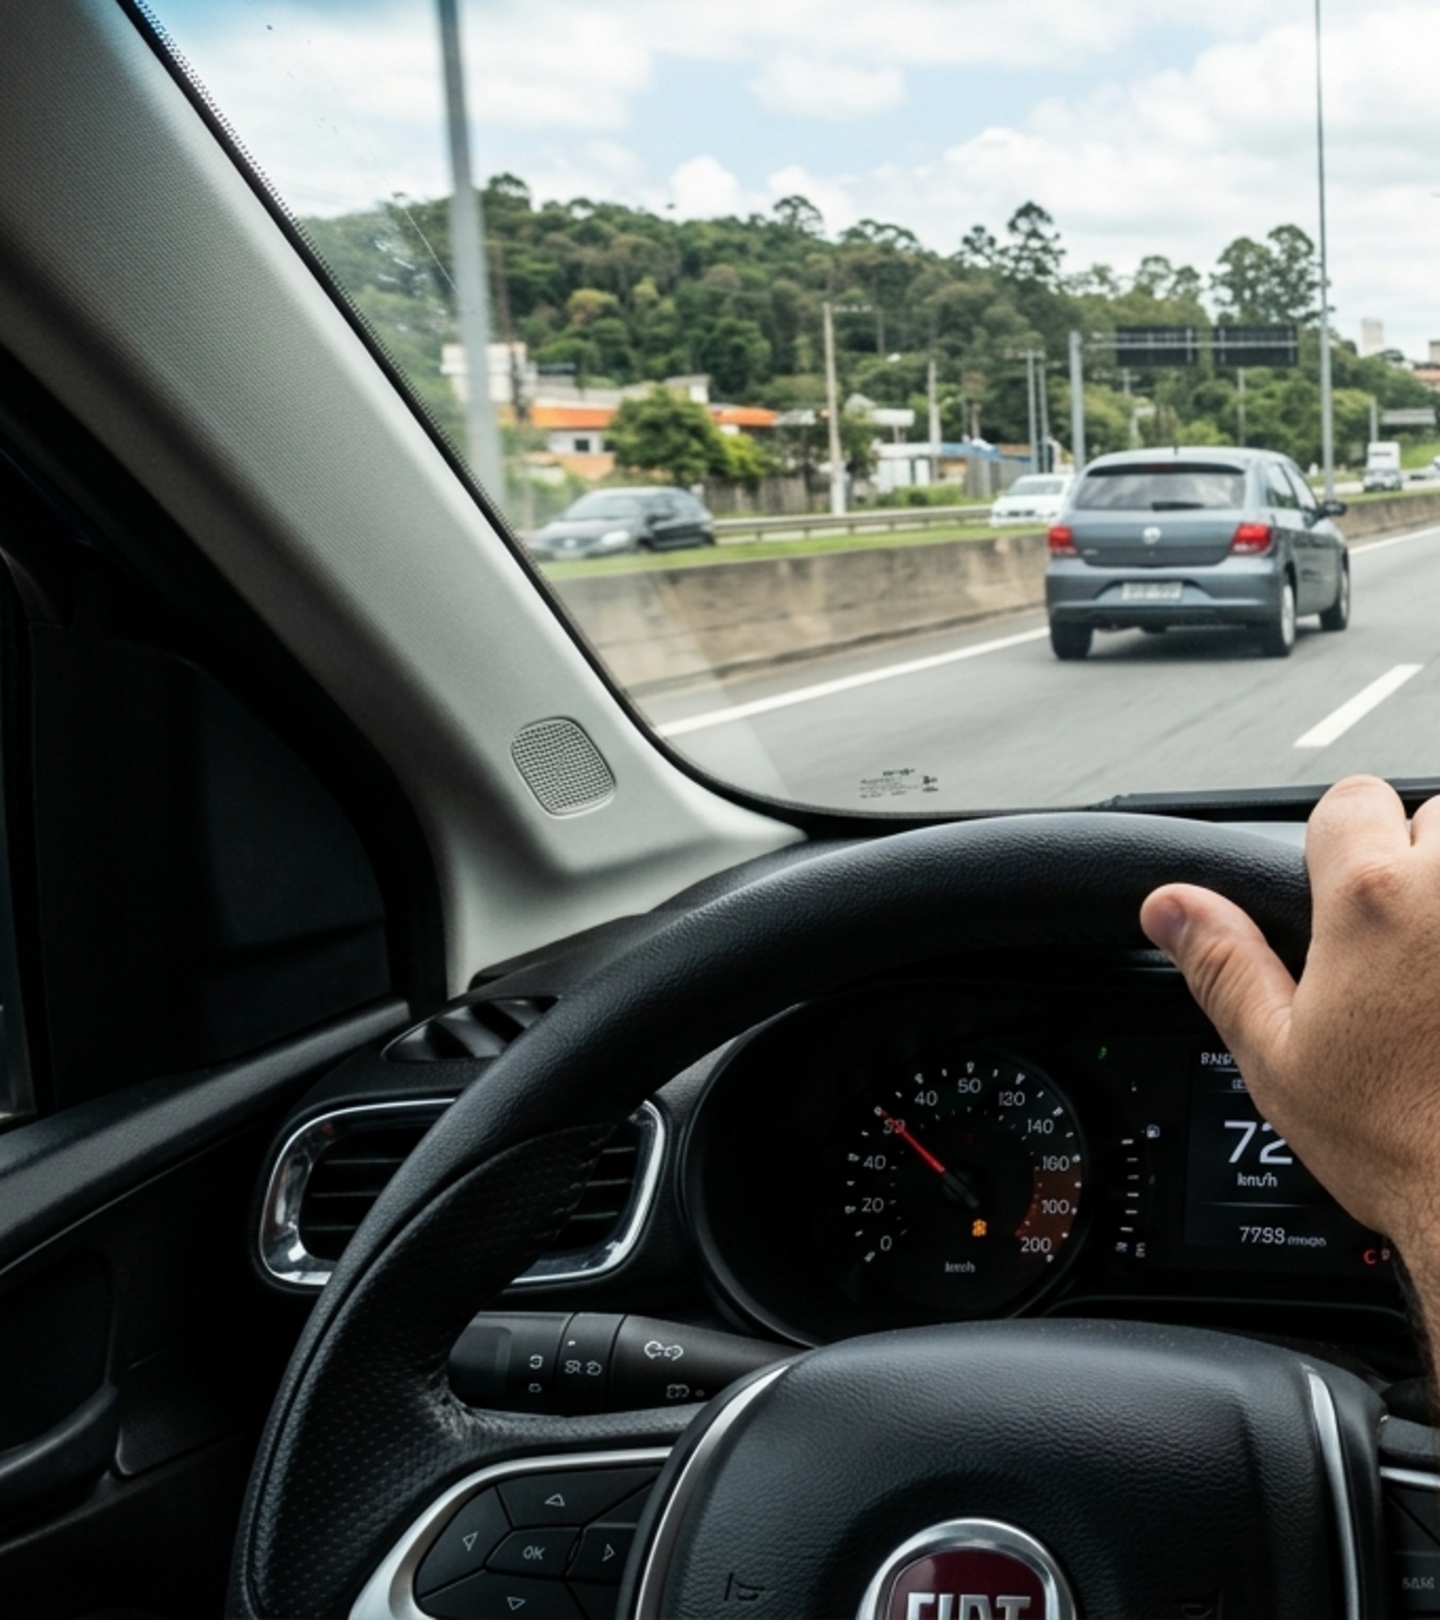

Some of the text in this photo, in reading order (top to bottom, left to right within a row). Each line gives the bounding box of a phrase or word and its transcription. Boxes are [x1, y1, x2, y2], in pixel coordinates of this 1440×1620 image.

[914, 1090, 938, 1106] 40
[1027, 1119, 1054, 1133] 140
[1224, 1120, 1293, 1165] 72
[863, 1155, 886, 1169] 40
[862, 1198, 884, 1213] 20
[880, 1236, 892, 1250] 0
[1021, 1236, 1052, 1252] 200
[523, 1545, 546, 1560] OK
